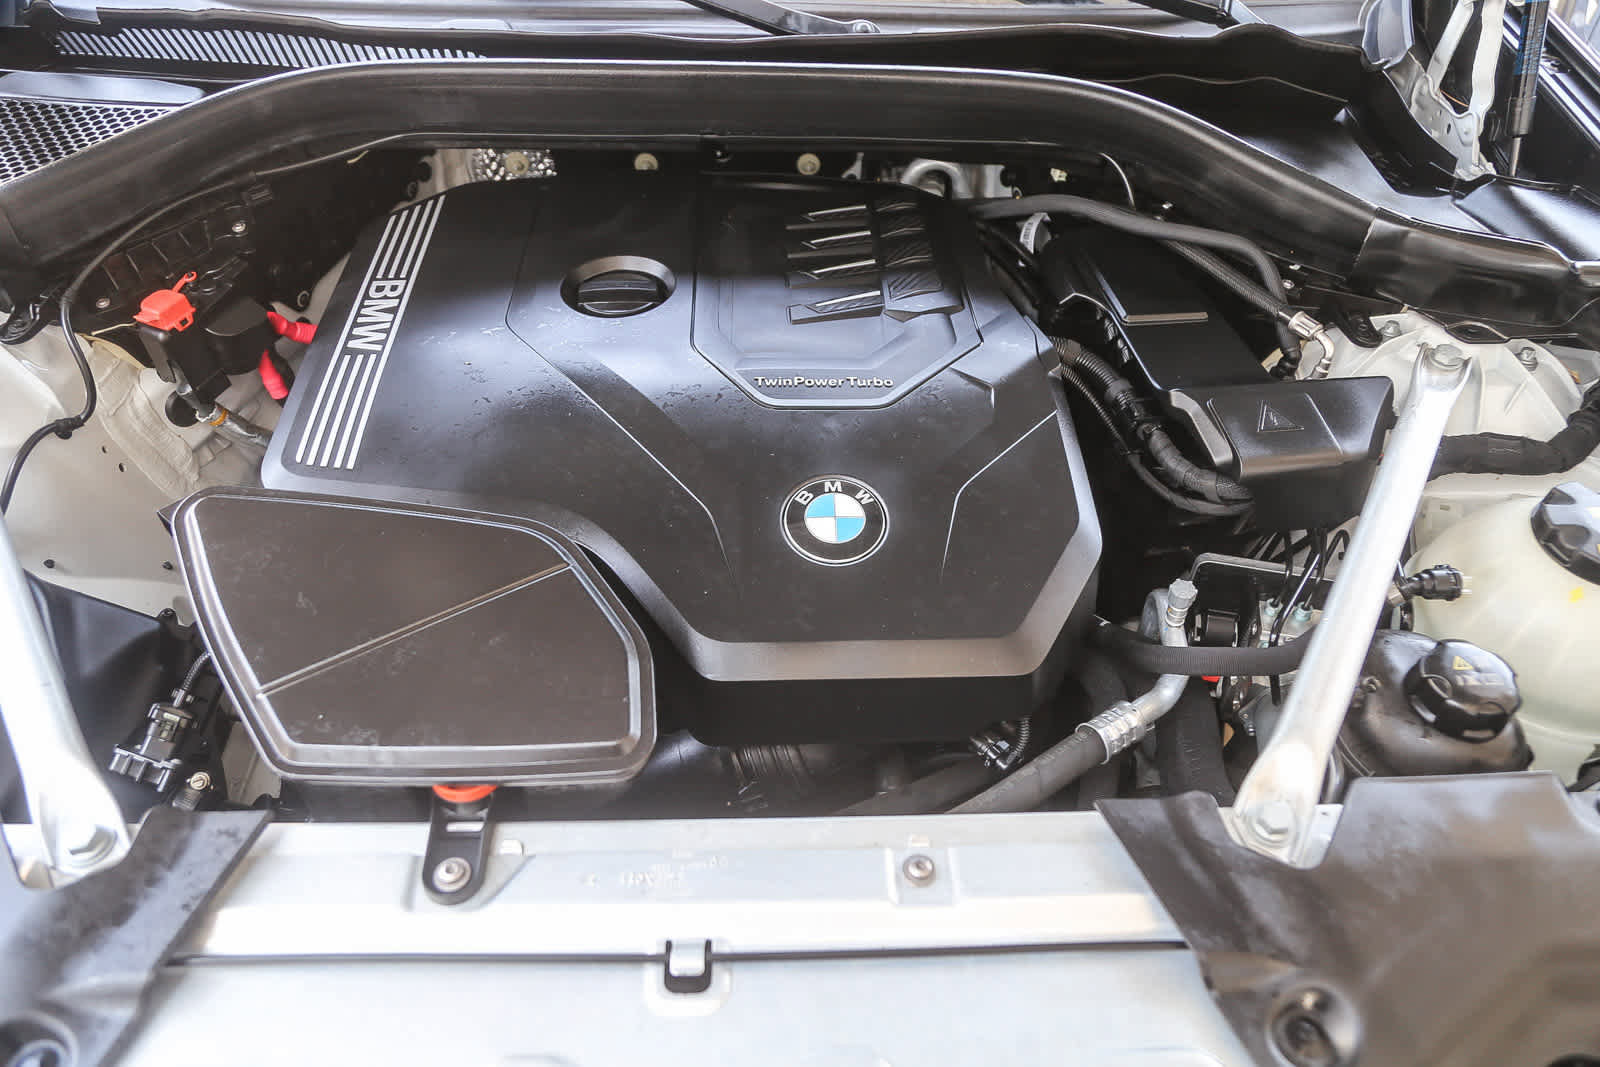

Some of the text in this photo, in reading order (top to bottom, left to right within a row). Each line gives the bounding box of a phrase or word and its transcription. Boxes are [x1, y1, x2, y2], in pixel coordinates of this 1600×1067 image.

[346, 279, 407, 351] BMW
[845, 376, 894, 388] Turbo
[794, 480, 875, 506] BMW
